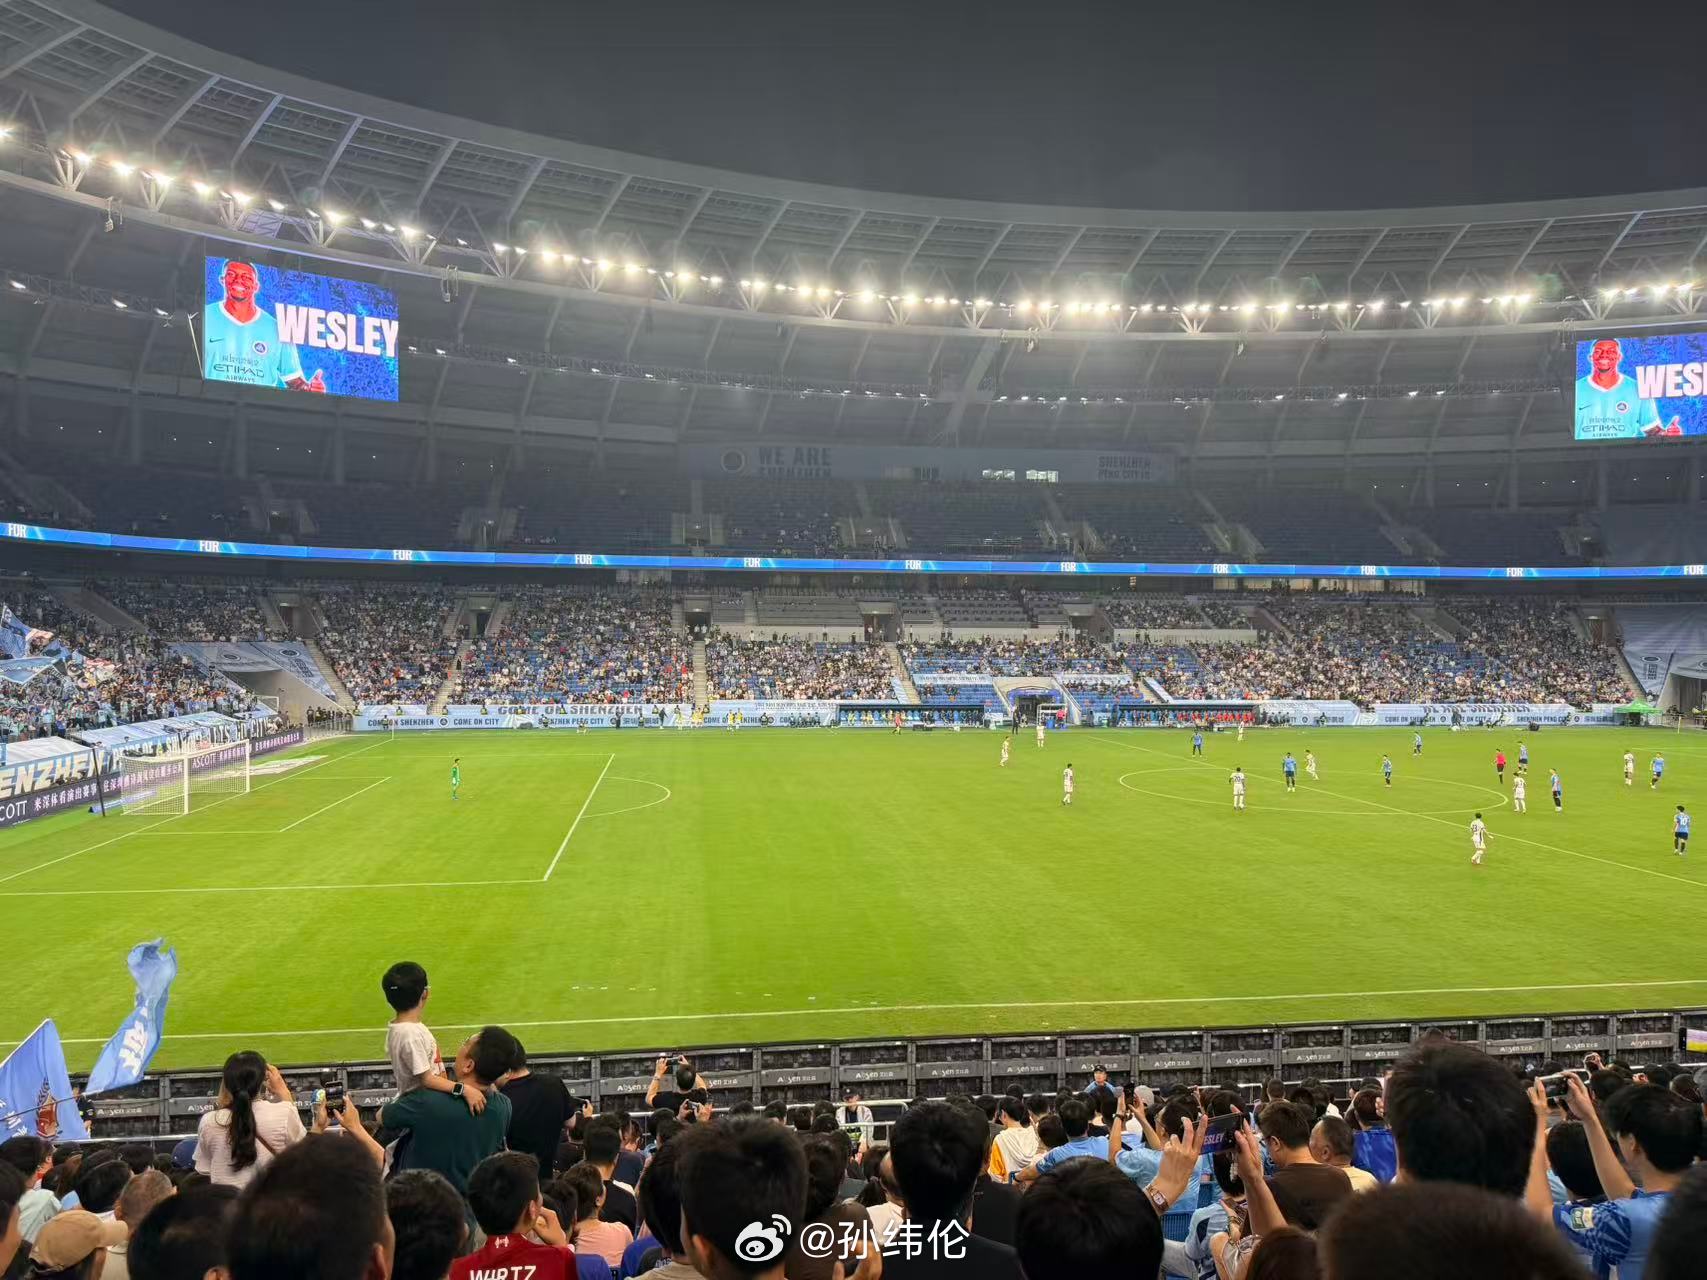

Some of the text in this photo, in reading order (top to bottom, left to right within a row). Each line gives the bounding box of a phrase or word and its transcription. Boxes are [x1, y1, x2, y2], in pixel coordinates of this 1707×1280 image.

[275, 303, 398, 357] WESLEY
[214, 364, 264, 378] ETIHAD
[226, 374, 255, 382] AIRWAYS
[758, 448, 831, 465] WE ARE
[8, 523, 26, 538] FOR
[200, 540, 220, 552] FOR
[393, 550, 412, 560] FOR
[575, 554, 592, 565] FOR
[743, 558, 761, 568] FOR
[905, 560, 921, 569] FOR
[1060, 562, 1076, 572] FOR
[1213, 564, 1228, 573] FOR
[1360, 566, 1376, 575] FOR
[1507, 568, 1523, 577] FOR
[1684, 565, 1704, 575] FOR
[400, 718, 434, 726] SHENZHEN
[590, 717, 604, 725] CITY
[1007, 1066, 1029, 1074] Asen
[777, 1076, 800, 1084] Asen
[1203, 1133, 1224, 1145] ESLEY
